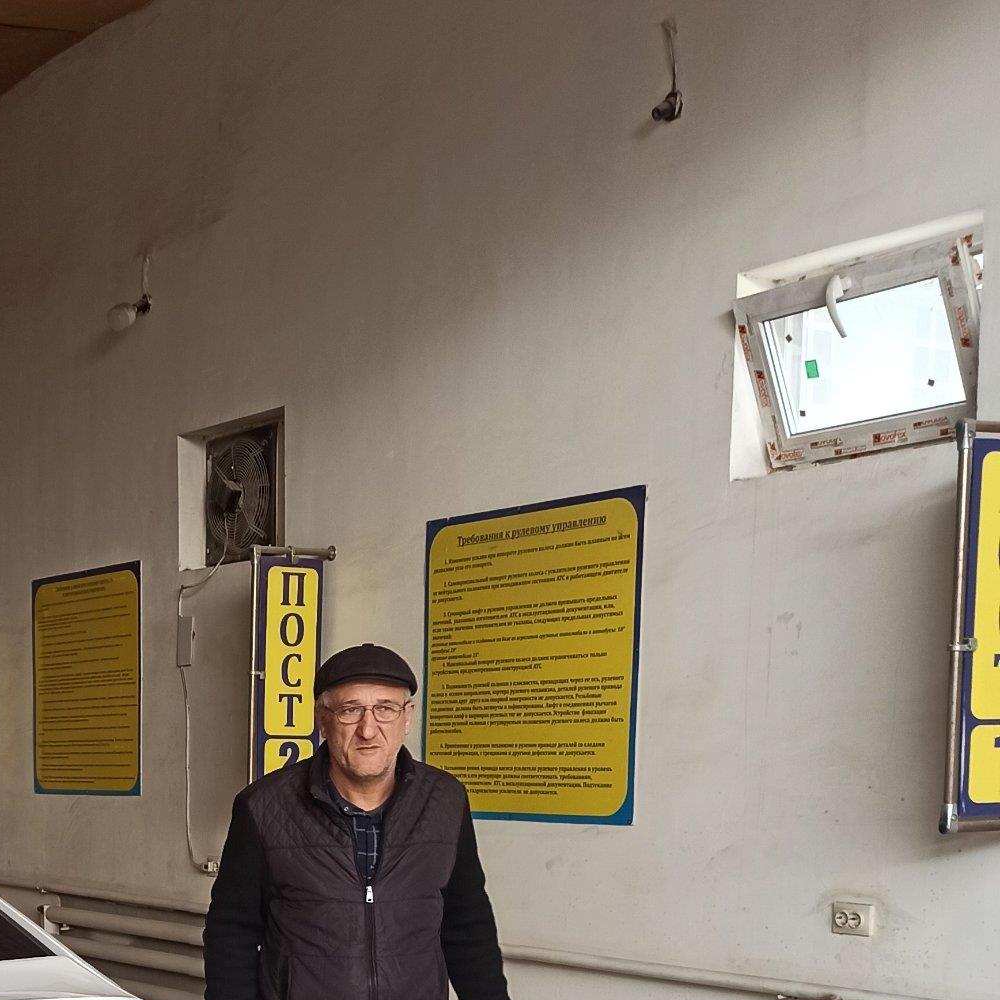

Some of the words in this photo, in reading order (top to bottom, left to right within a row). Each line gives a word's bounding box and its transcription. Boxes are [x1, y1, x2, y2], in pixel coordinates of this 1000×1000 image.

[456, 531, 504, 547] Требования
[504, 530, 511, 539] к
[511, 523, 550, 539] рулевому
[551, 515, 607, 531] управлению
[278, 571, 307, 728] ПОСТ
[278, 741, 300, 769] 2
